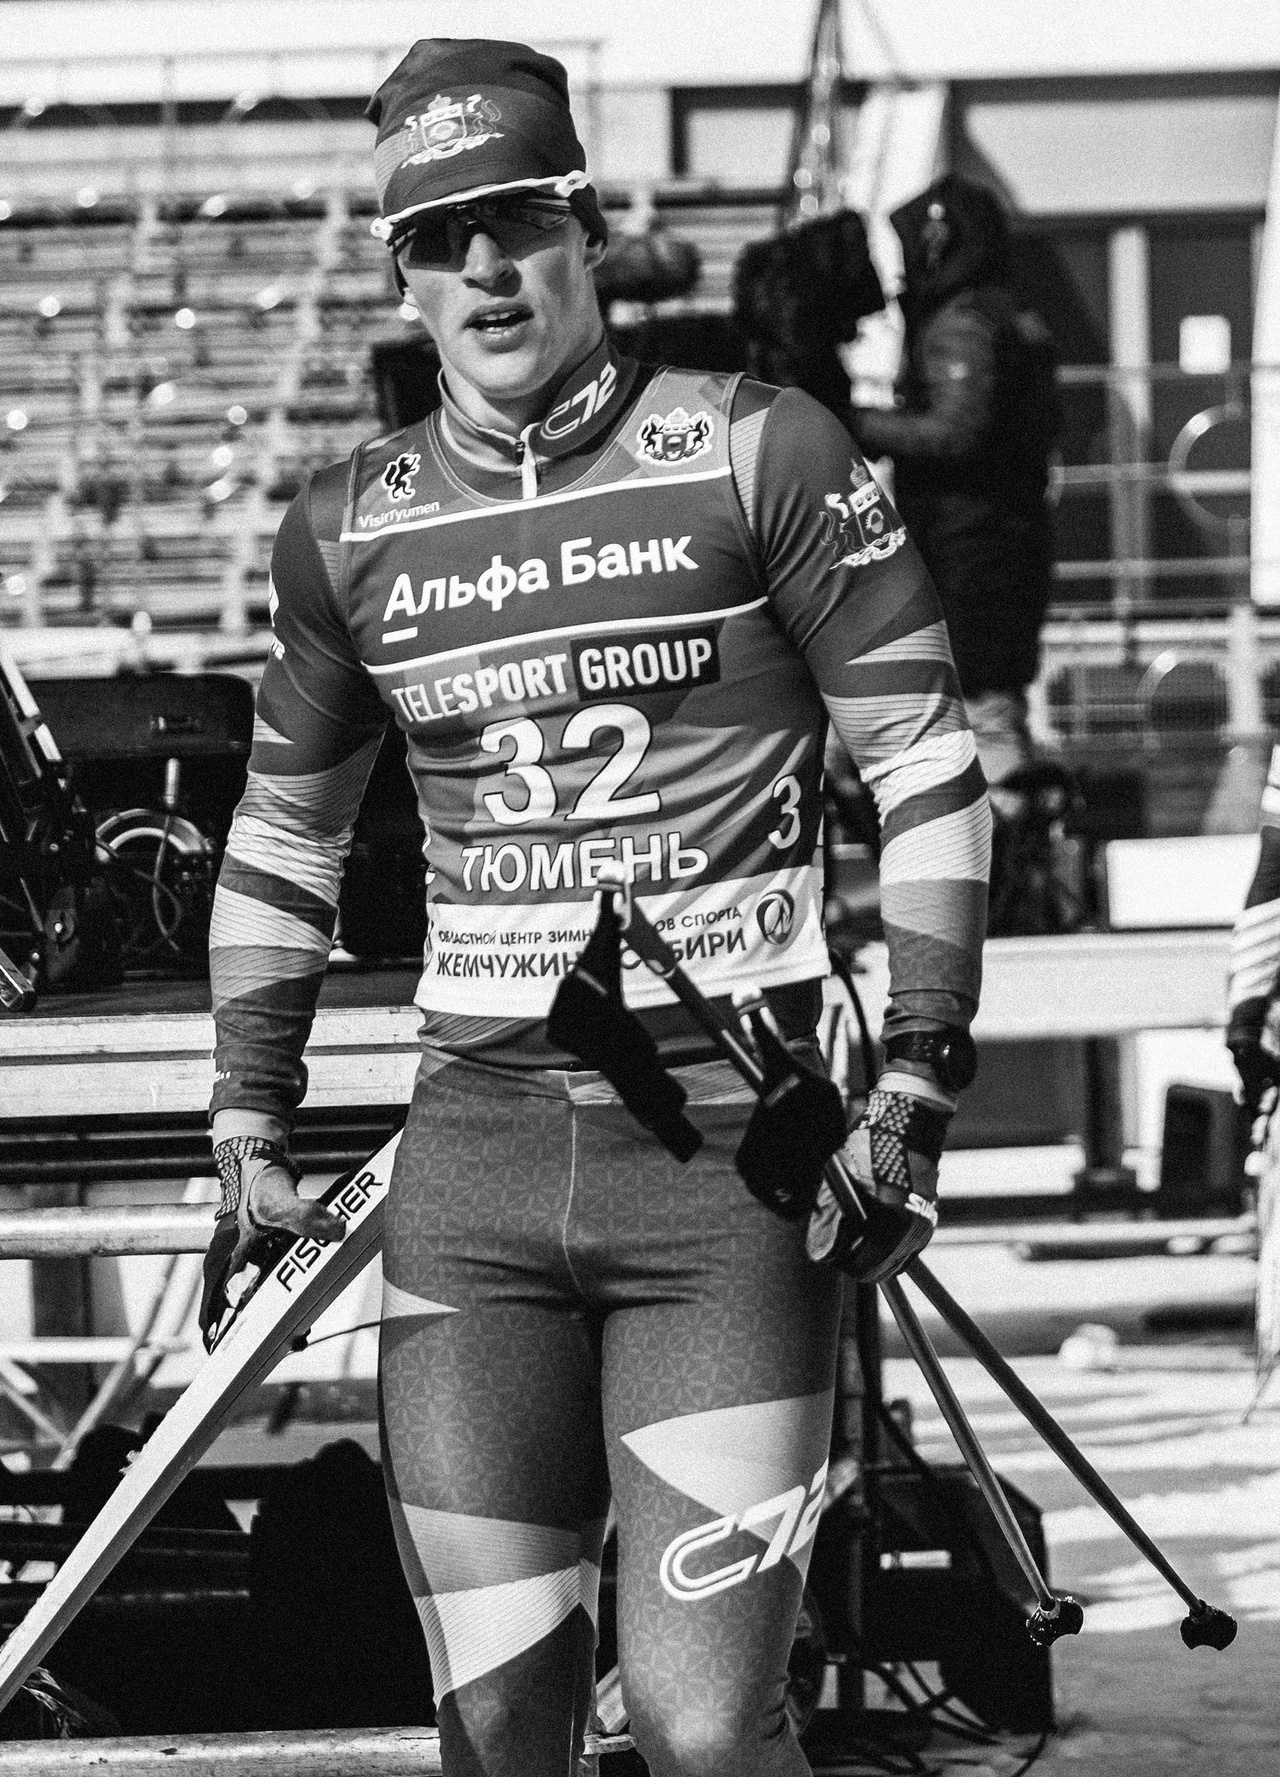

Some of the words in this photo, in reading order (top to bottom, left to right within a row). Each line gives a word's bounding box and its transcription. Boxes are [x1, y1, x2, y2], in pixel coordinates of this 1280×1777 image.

[358, 501, 440, 529] VisitTyumen
[382, 554, 550, 623] Альфа
[560, 534, 700, 587] Банк
[391, 653, 568, 723] TELESPORT
[578, 637, 714, 692] GROUP
[479, 702, 662, 827] 32
[767, 773, 802, 850] 3
[460, 831, 710, 893] ТЮМЕНЬ
[500, 931, 543, 947] ЦЕНТР
[548, 929, 594, 943] ЗИМН
[681, 906, 743, 929] СПОРТА
